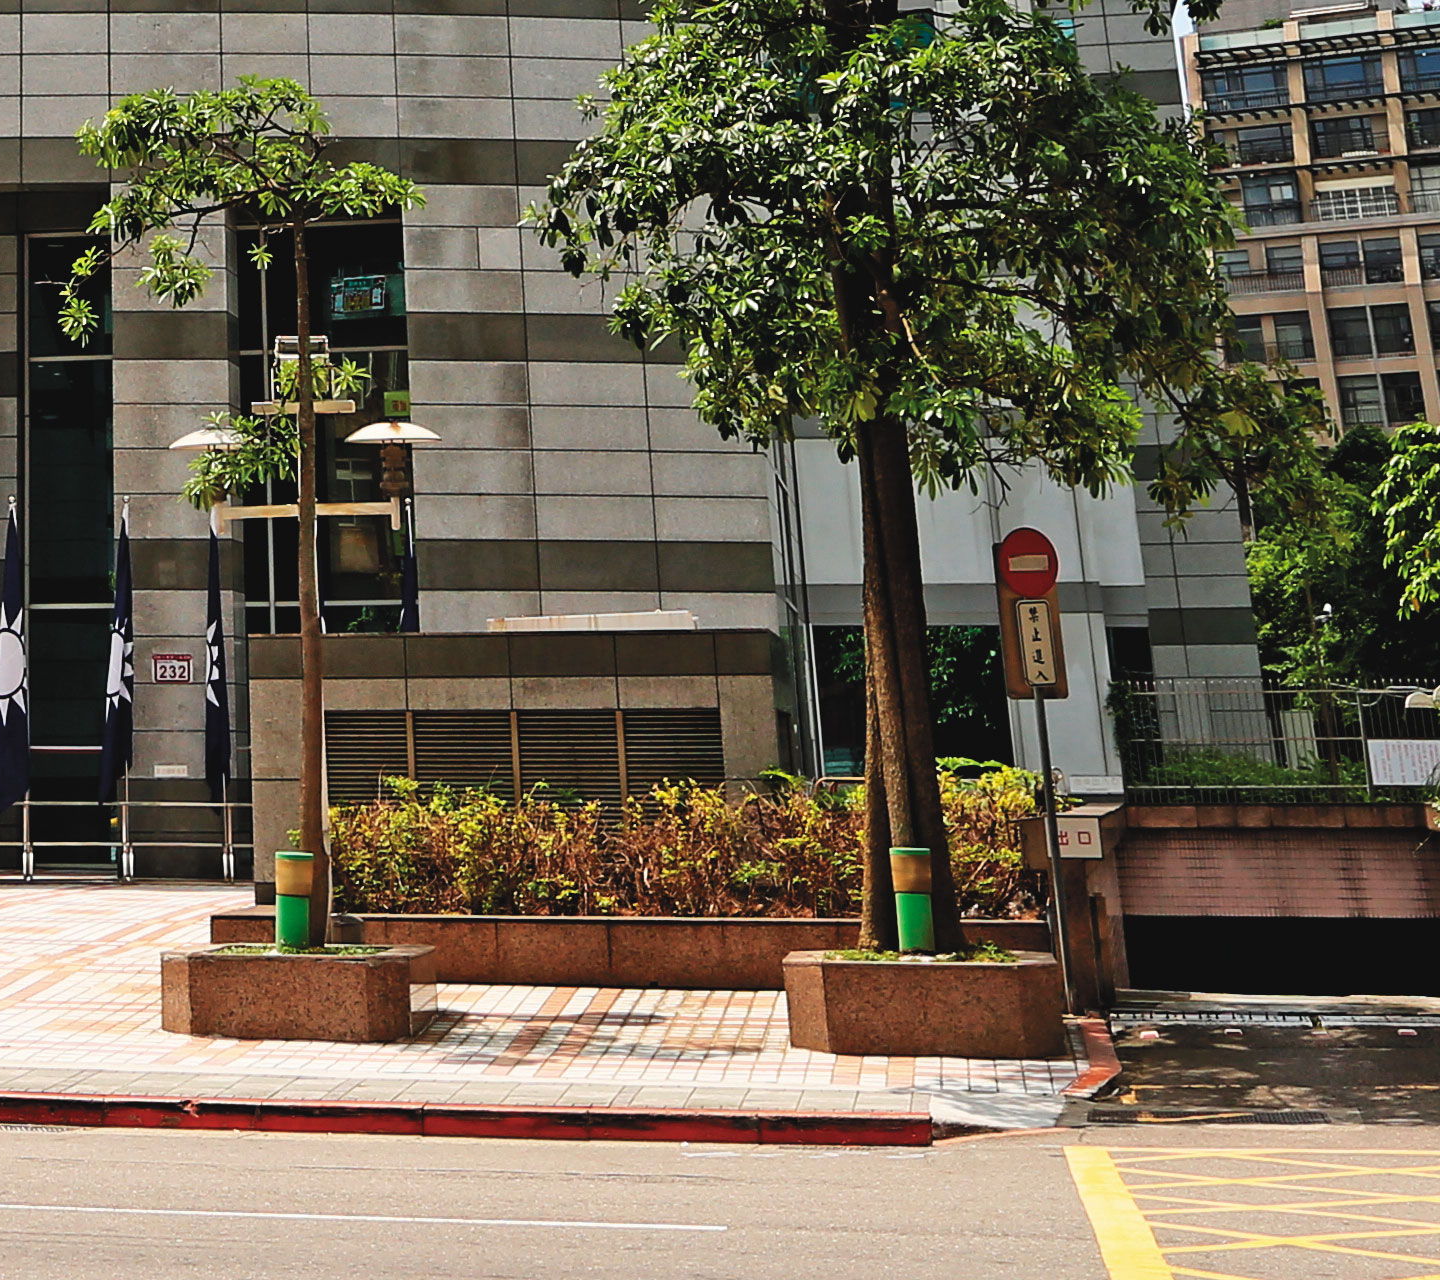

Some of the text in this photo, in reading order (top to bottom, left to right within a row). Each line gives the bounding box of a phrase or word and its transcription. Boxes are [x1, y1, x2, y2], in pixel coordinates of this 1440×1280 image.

[1028, 606, 1049, 681] 禁止進入
[159, 665, 187, 679] 232
[1058, 830, 1092, 846] 出口
